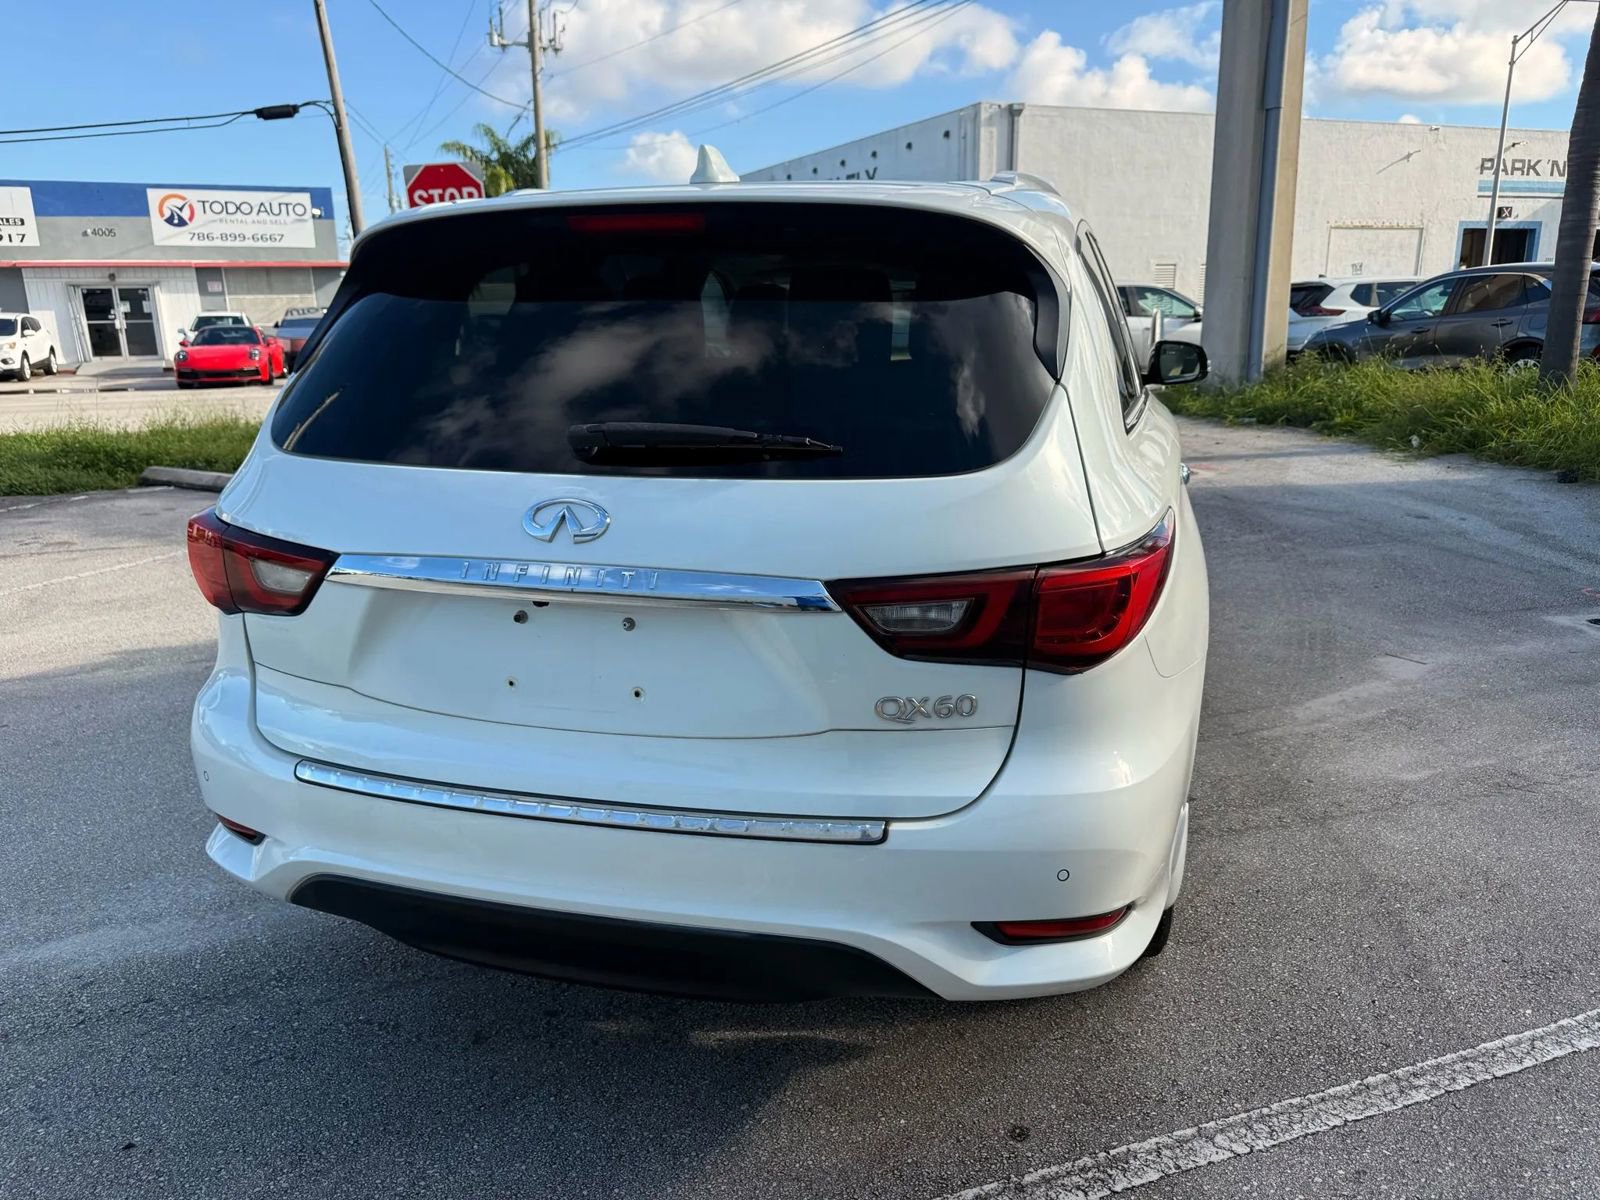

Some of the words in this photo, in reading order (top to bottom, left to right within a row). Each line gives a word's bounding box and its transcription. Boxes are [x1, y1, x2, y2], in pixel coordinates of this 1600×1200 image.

[1479, 158, 1541, 176] PARK
[413, 186, 480, 207] STOP
[197, 200, 253, 216] TODO
[256, 202, 307, 217] AUTO
[91, 228, 117, 238] 4005
[188, 231, 285, 243] 786-899-6667
[460, 560, 658, 590] INFINITI
[875, 694, 977, 725] QX60
